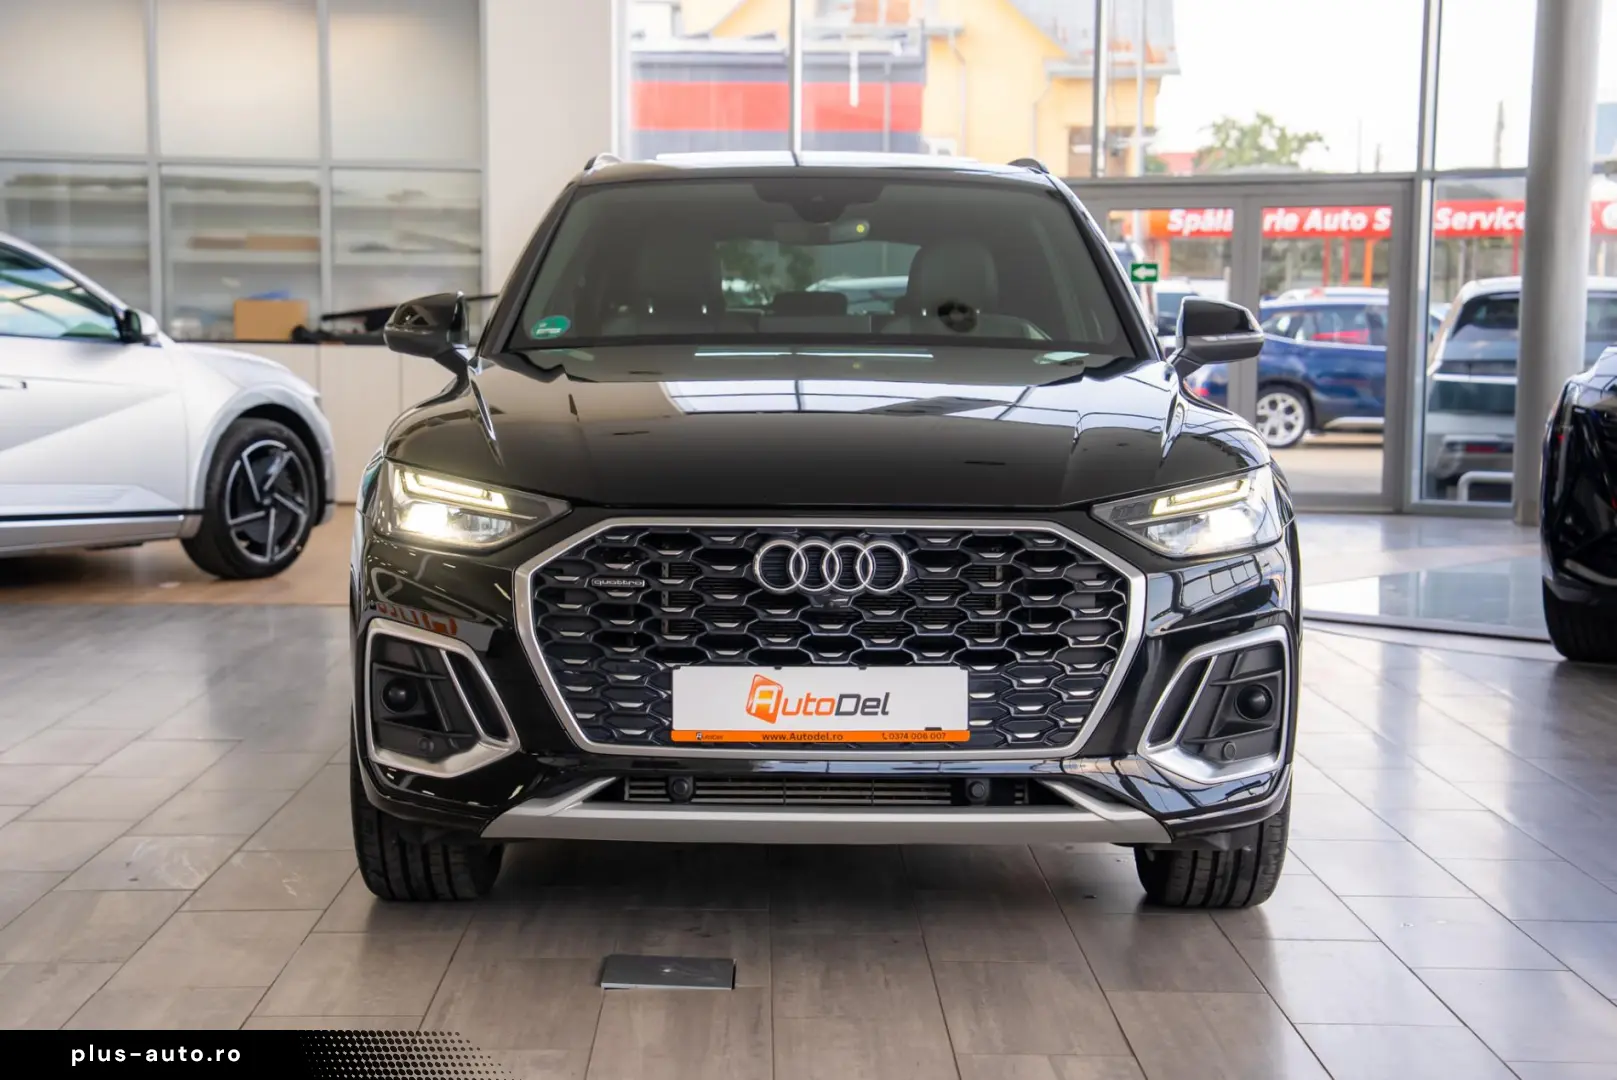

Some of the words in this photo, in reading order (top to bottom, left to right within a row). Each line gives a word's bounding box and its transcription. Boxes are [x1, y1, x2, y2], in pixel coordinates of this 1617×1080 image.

[1303, 209, 1369, 232] Auto
[593, 579, 643, 587] quattro
[747, 680, 890, 718] AutoDel
[761, 732, 844, 742] www.Autodel.ro
[888, 732, 909, 741] 0374
[911, 732, 929, 741] 006
[930, 732, 947, 741] 007
